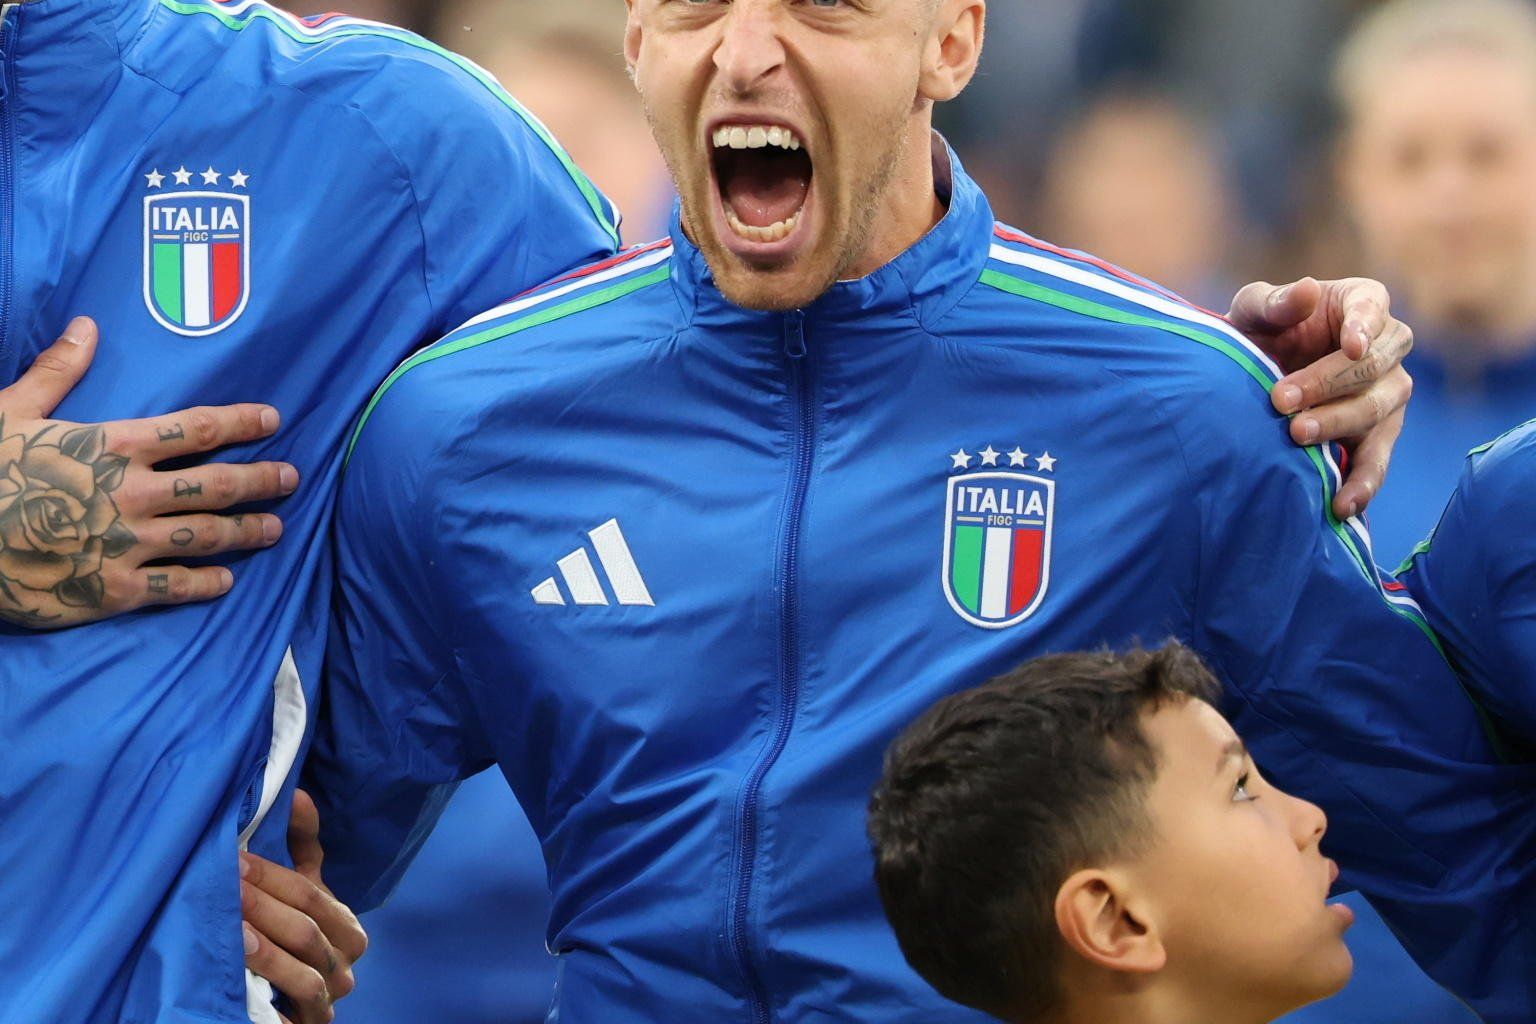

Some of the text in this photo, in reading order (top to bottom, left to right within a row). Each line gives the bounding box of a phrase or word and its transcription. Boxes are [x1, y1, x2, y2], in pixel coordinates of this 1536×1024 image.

[152, 206, 240, 231] ITALIA
[183, 232, 209, 242] FIGC
[957, 486, 1045, 516] ITALIA
[987, 515, 1013, 526] FIGC
